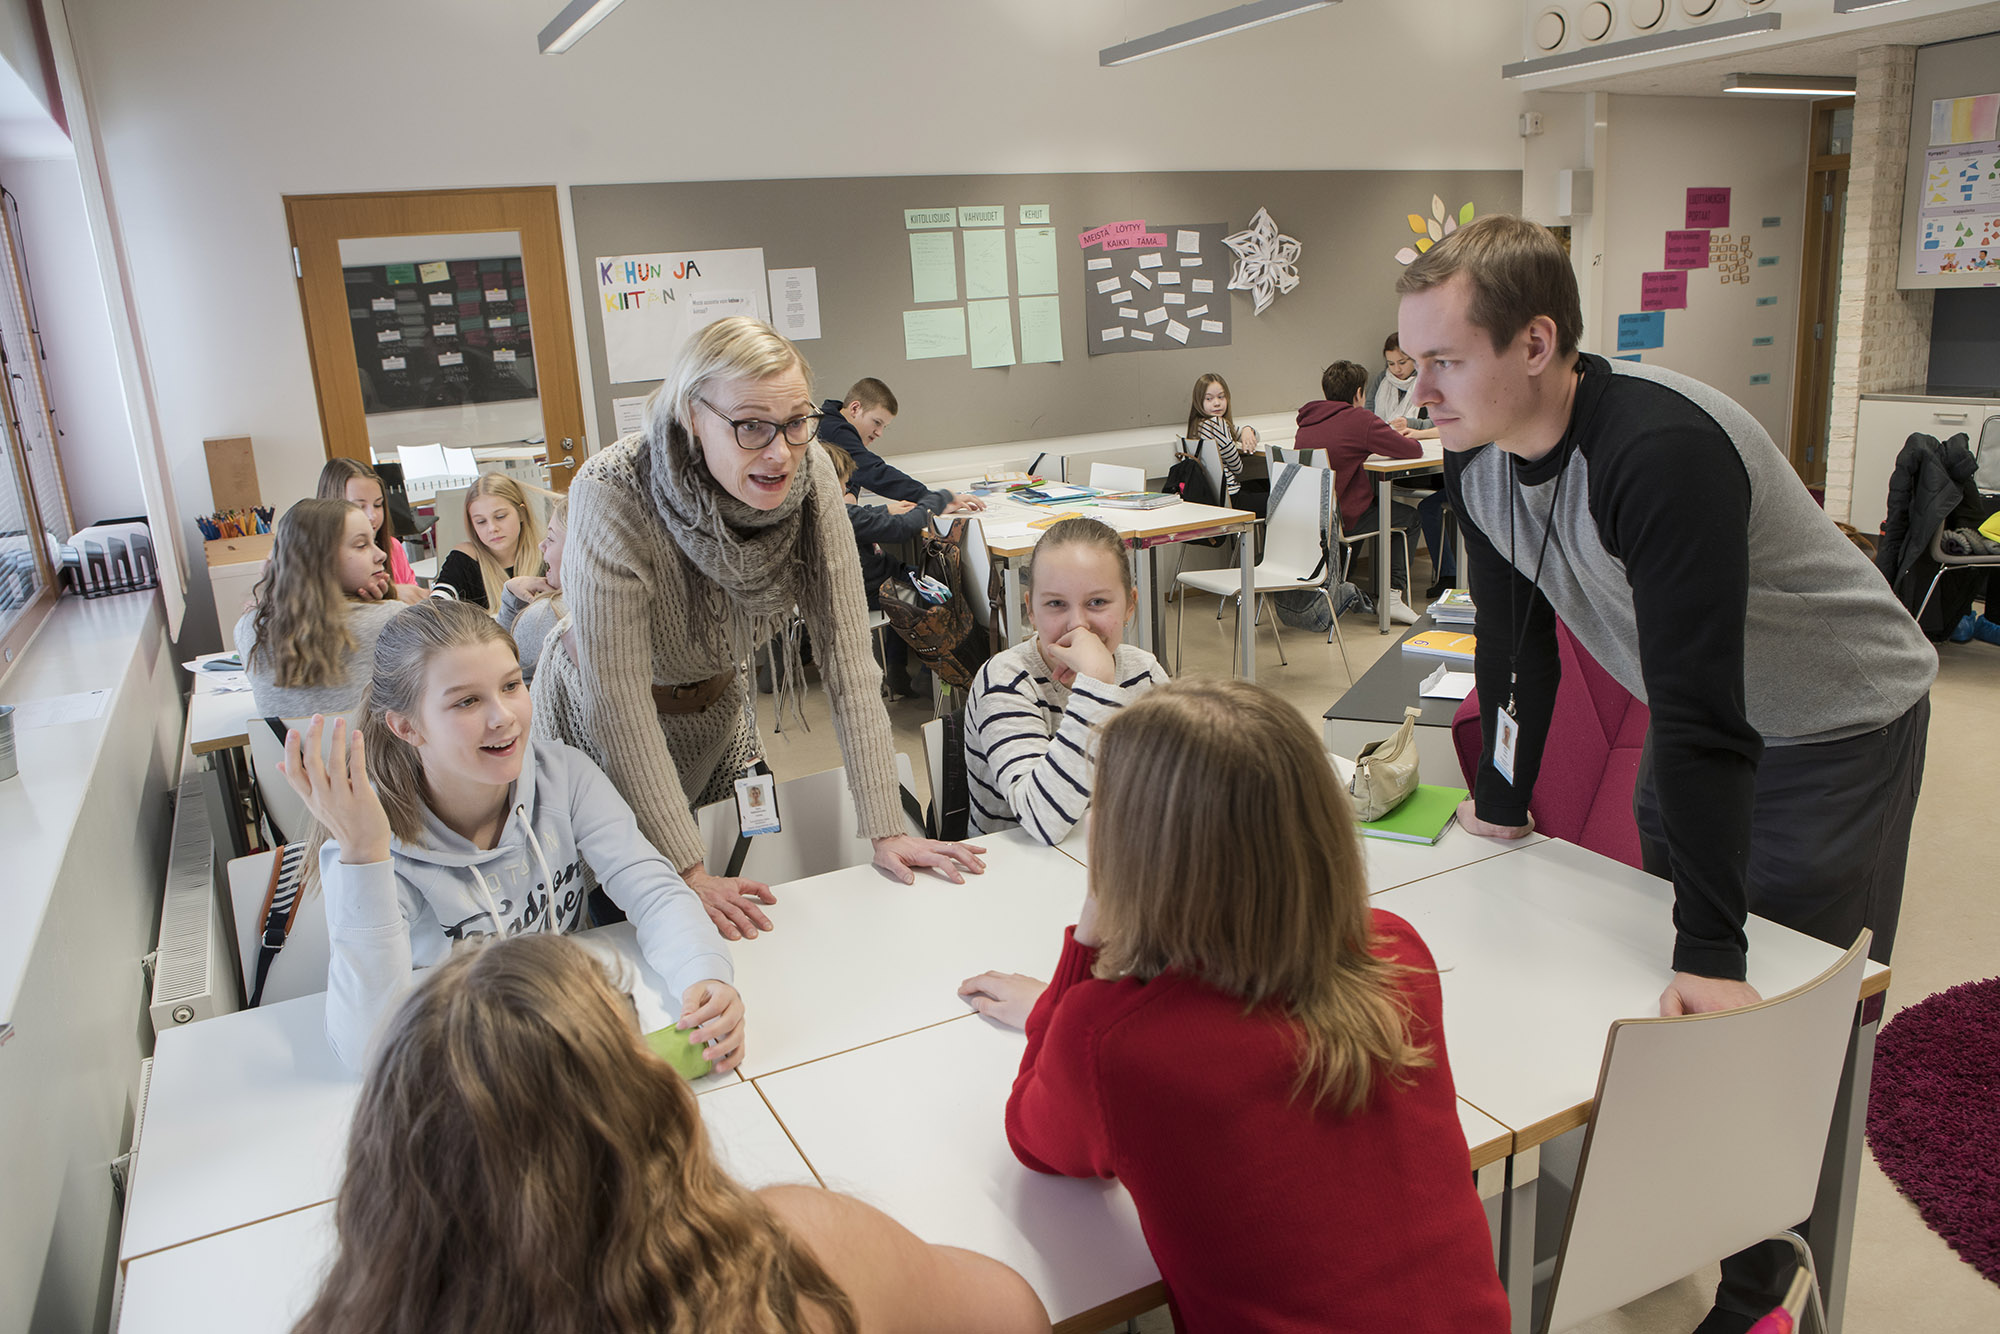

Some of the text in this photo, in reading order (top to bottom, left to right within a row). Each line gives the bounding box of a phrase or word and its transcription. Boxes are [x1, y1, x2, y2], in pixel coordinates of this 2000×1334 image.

[910, 212, 951, 224] KIITOLLISUUS
[964, 211, 998, 222] VAHVUUDET
[1024, 209, 1043, 219] KEHUT
[1115, 223, 1141, 234] LÖYTYY
[1106, 238, 1130, 248] KAIKKI
[600, 260, 701, 286] KEHUN JA
